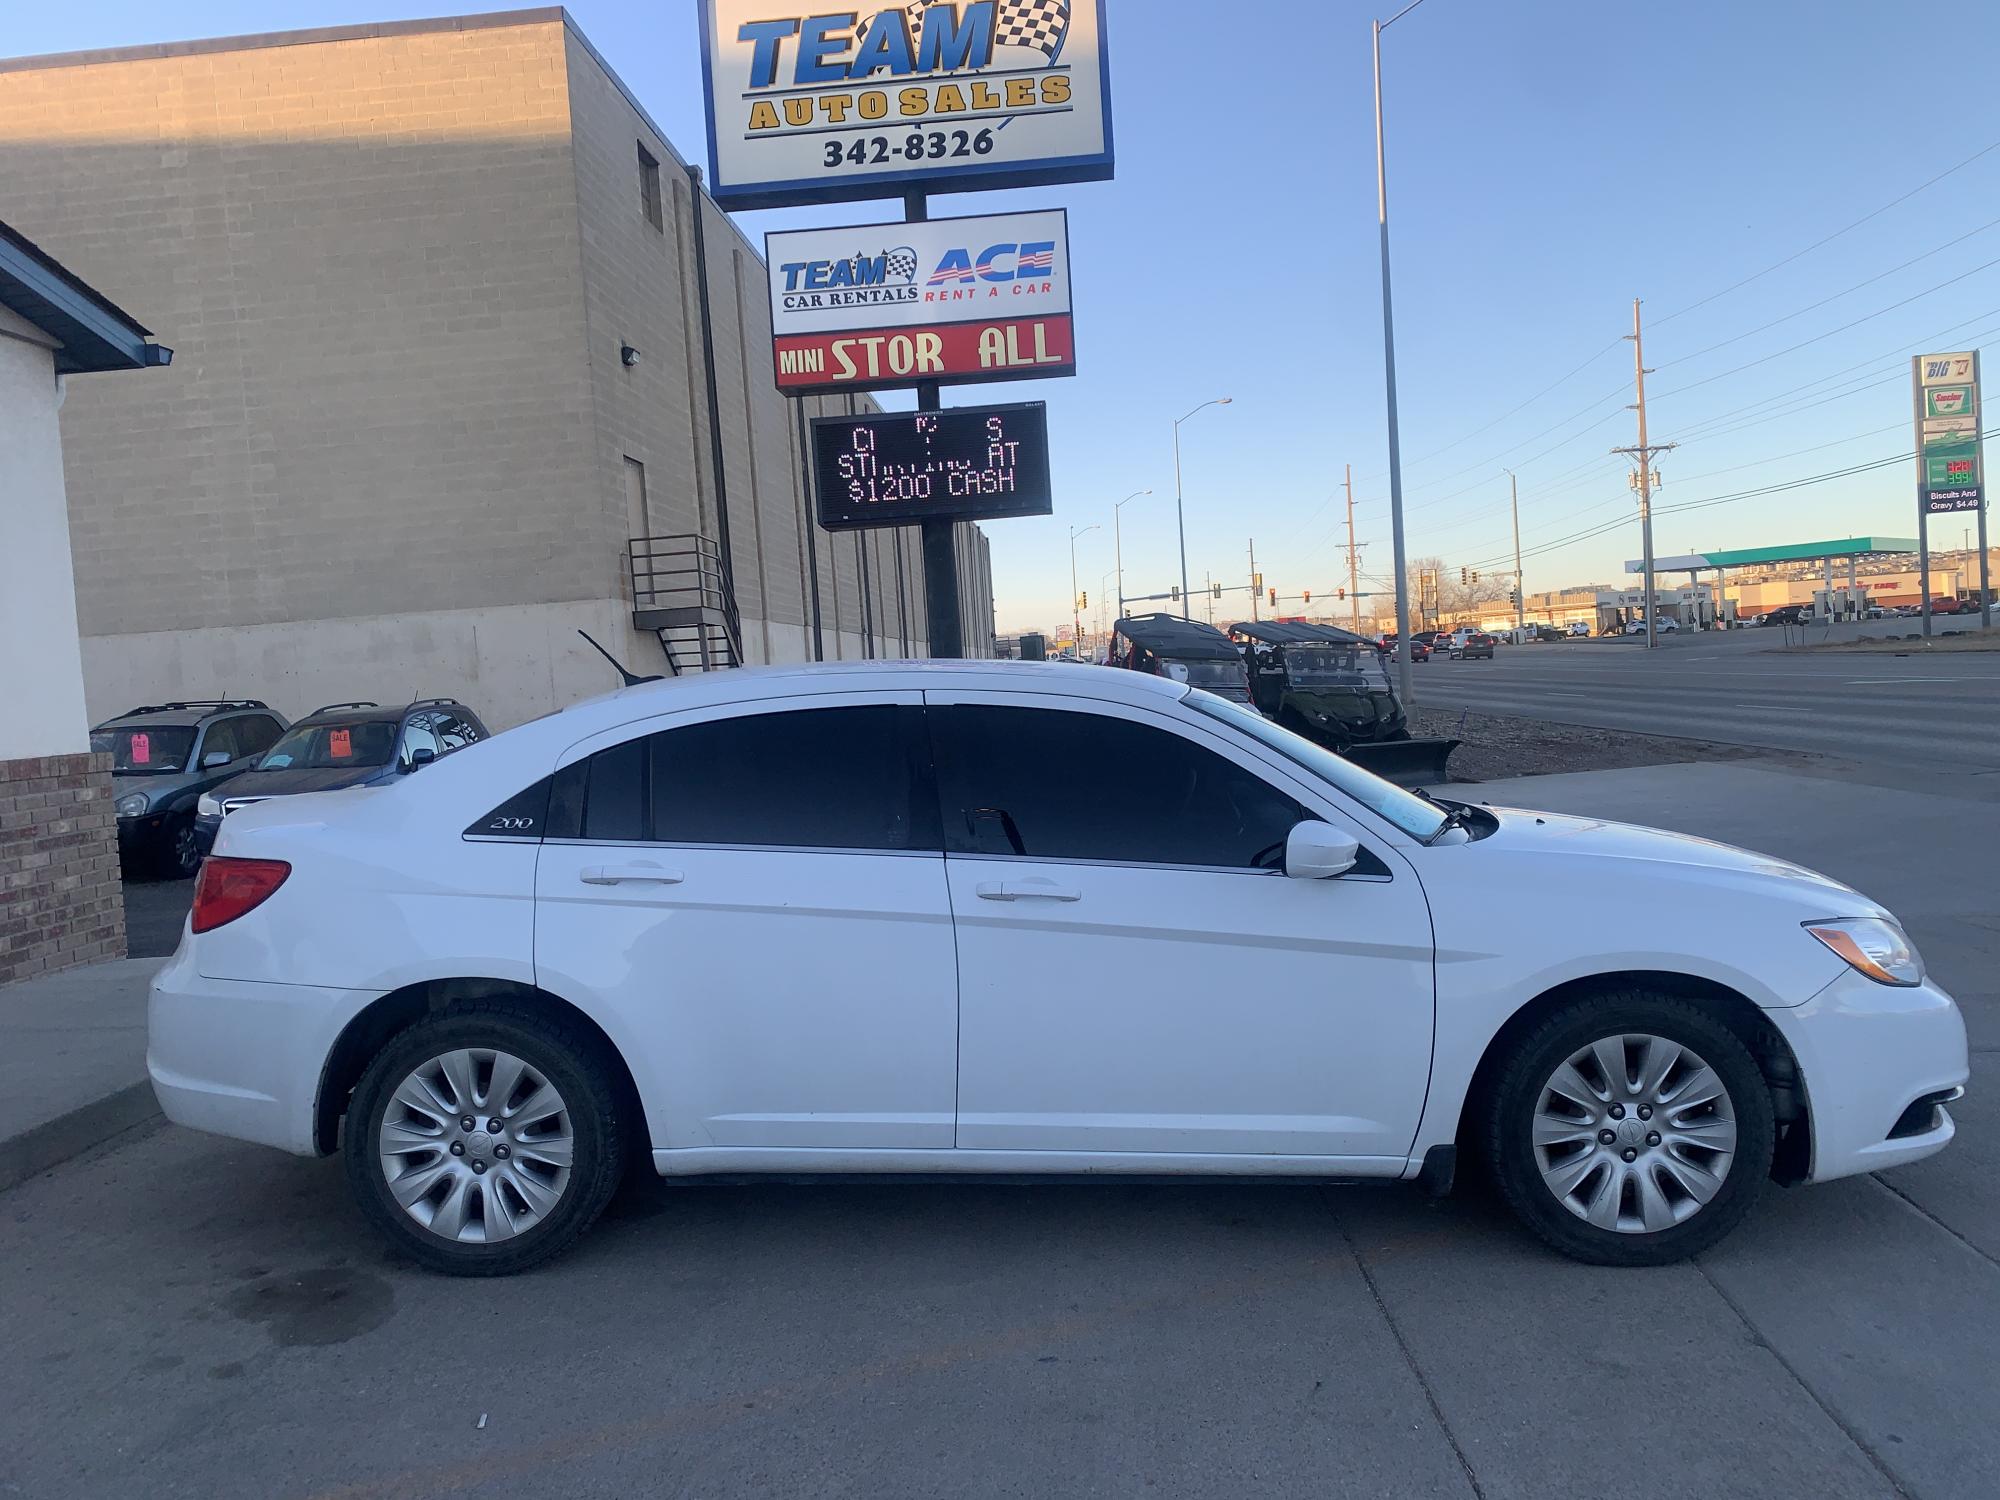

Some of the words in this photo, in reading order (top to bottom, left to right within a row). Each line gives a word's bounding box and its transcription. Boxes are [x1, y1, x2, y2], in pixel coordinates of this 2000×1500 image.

[738, 1, 999, 88] TEAM
[748, 90, 889, 131] AUTO
[899, 75, 1072, 116] SALES
[823, 129, 994, 168] 342-8326
[780, 255, 888, 292] TEAM
[926, 241, 1056, 286] ACE
[783, 293, 824, 309] CAR
[829, 287, 919, 306] RENTALS
[924, 288, 976, 303] RENT
[989, 286, 998, 298] A
[1012, 282, 1052, 296] CAR
[779, 348, 825, 376] MINI
[830, 332, 946, 381] STOR
[978, 323, 1063, 369] ALL
[848, 473, 931, 503] $1200
[948, 467, 1015, 498] CASH
[1930, 491, 1959, 500] Biscuits
[1961, 489, 1977, 498] And
[1930, 502, 1953, 511] Gravy
[331, 733, 349, 742] SALE
[489, 816, 534, 829] 200
